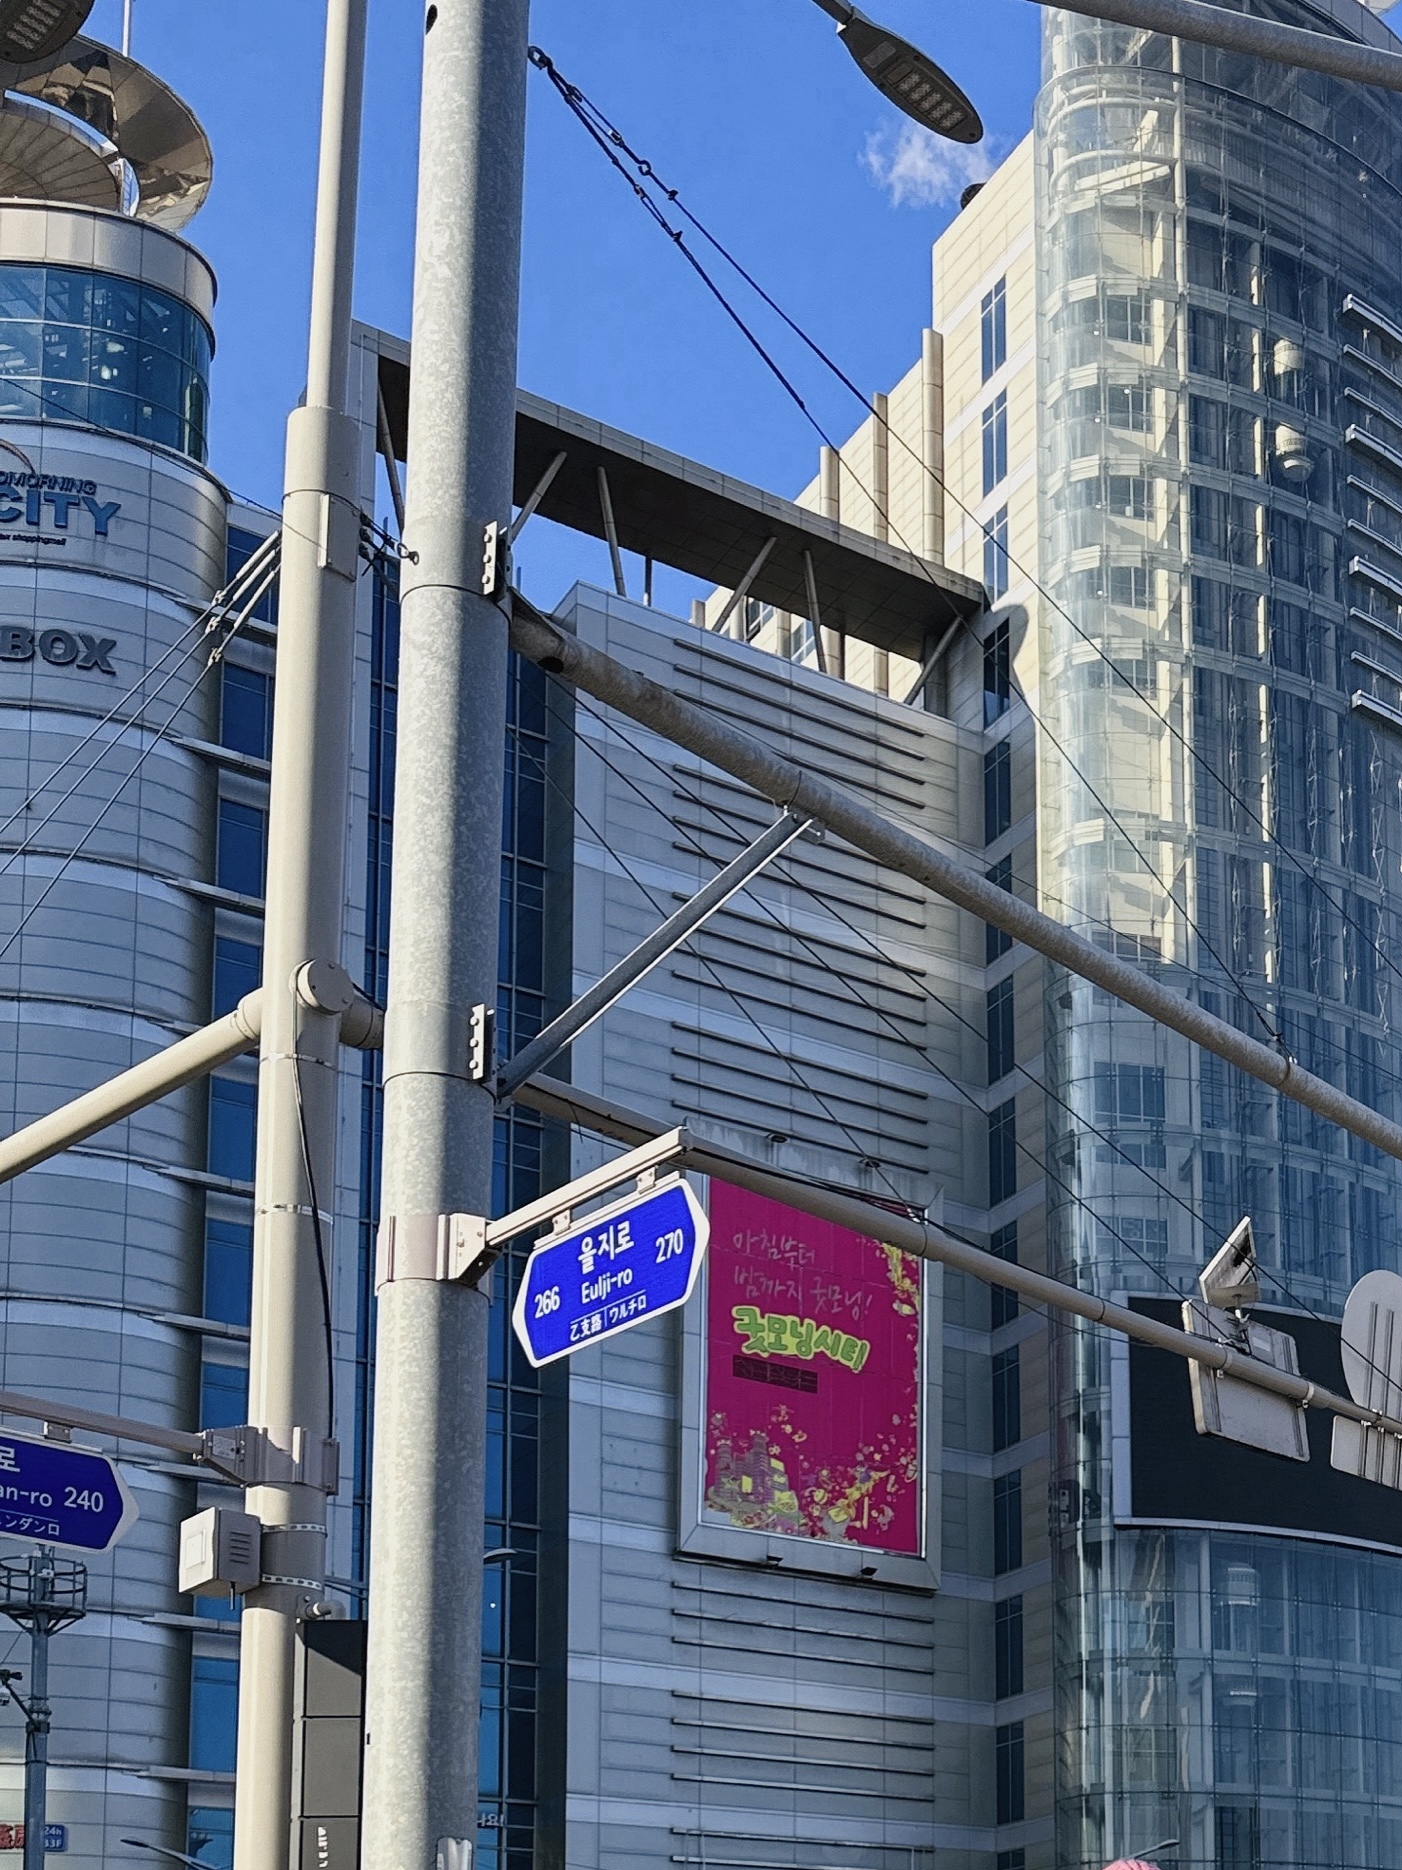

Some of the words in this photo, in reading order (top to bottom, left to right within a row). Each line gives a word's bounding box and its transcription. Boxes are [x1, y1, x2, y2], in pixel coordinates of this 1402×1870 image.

[0, 625, 117, 677] BOX
[578, 1220, 635, 1275] 을지로
[656, 1228, 684, 1264] 270
[733, 1229, 815, 1271] 아침부터
[534, 1286, 561, 1319] 266
[581, 1268, 633, 1304] Eulji-ro
[570, 1314, 602, 1342] 乙支路
[609, 1295, 647, 1324] ウルチロ
[734, 1266, 803, 1301] 밤까지
[810, 1276, 872, 1321] 굿모닝!
[731, 1305, 871, 1374] 굿모닝시티
[64, 1486, 104, 1513] 240
[0, 1515, 60, 1536] ンダンロ
